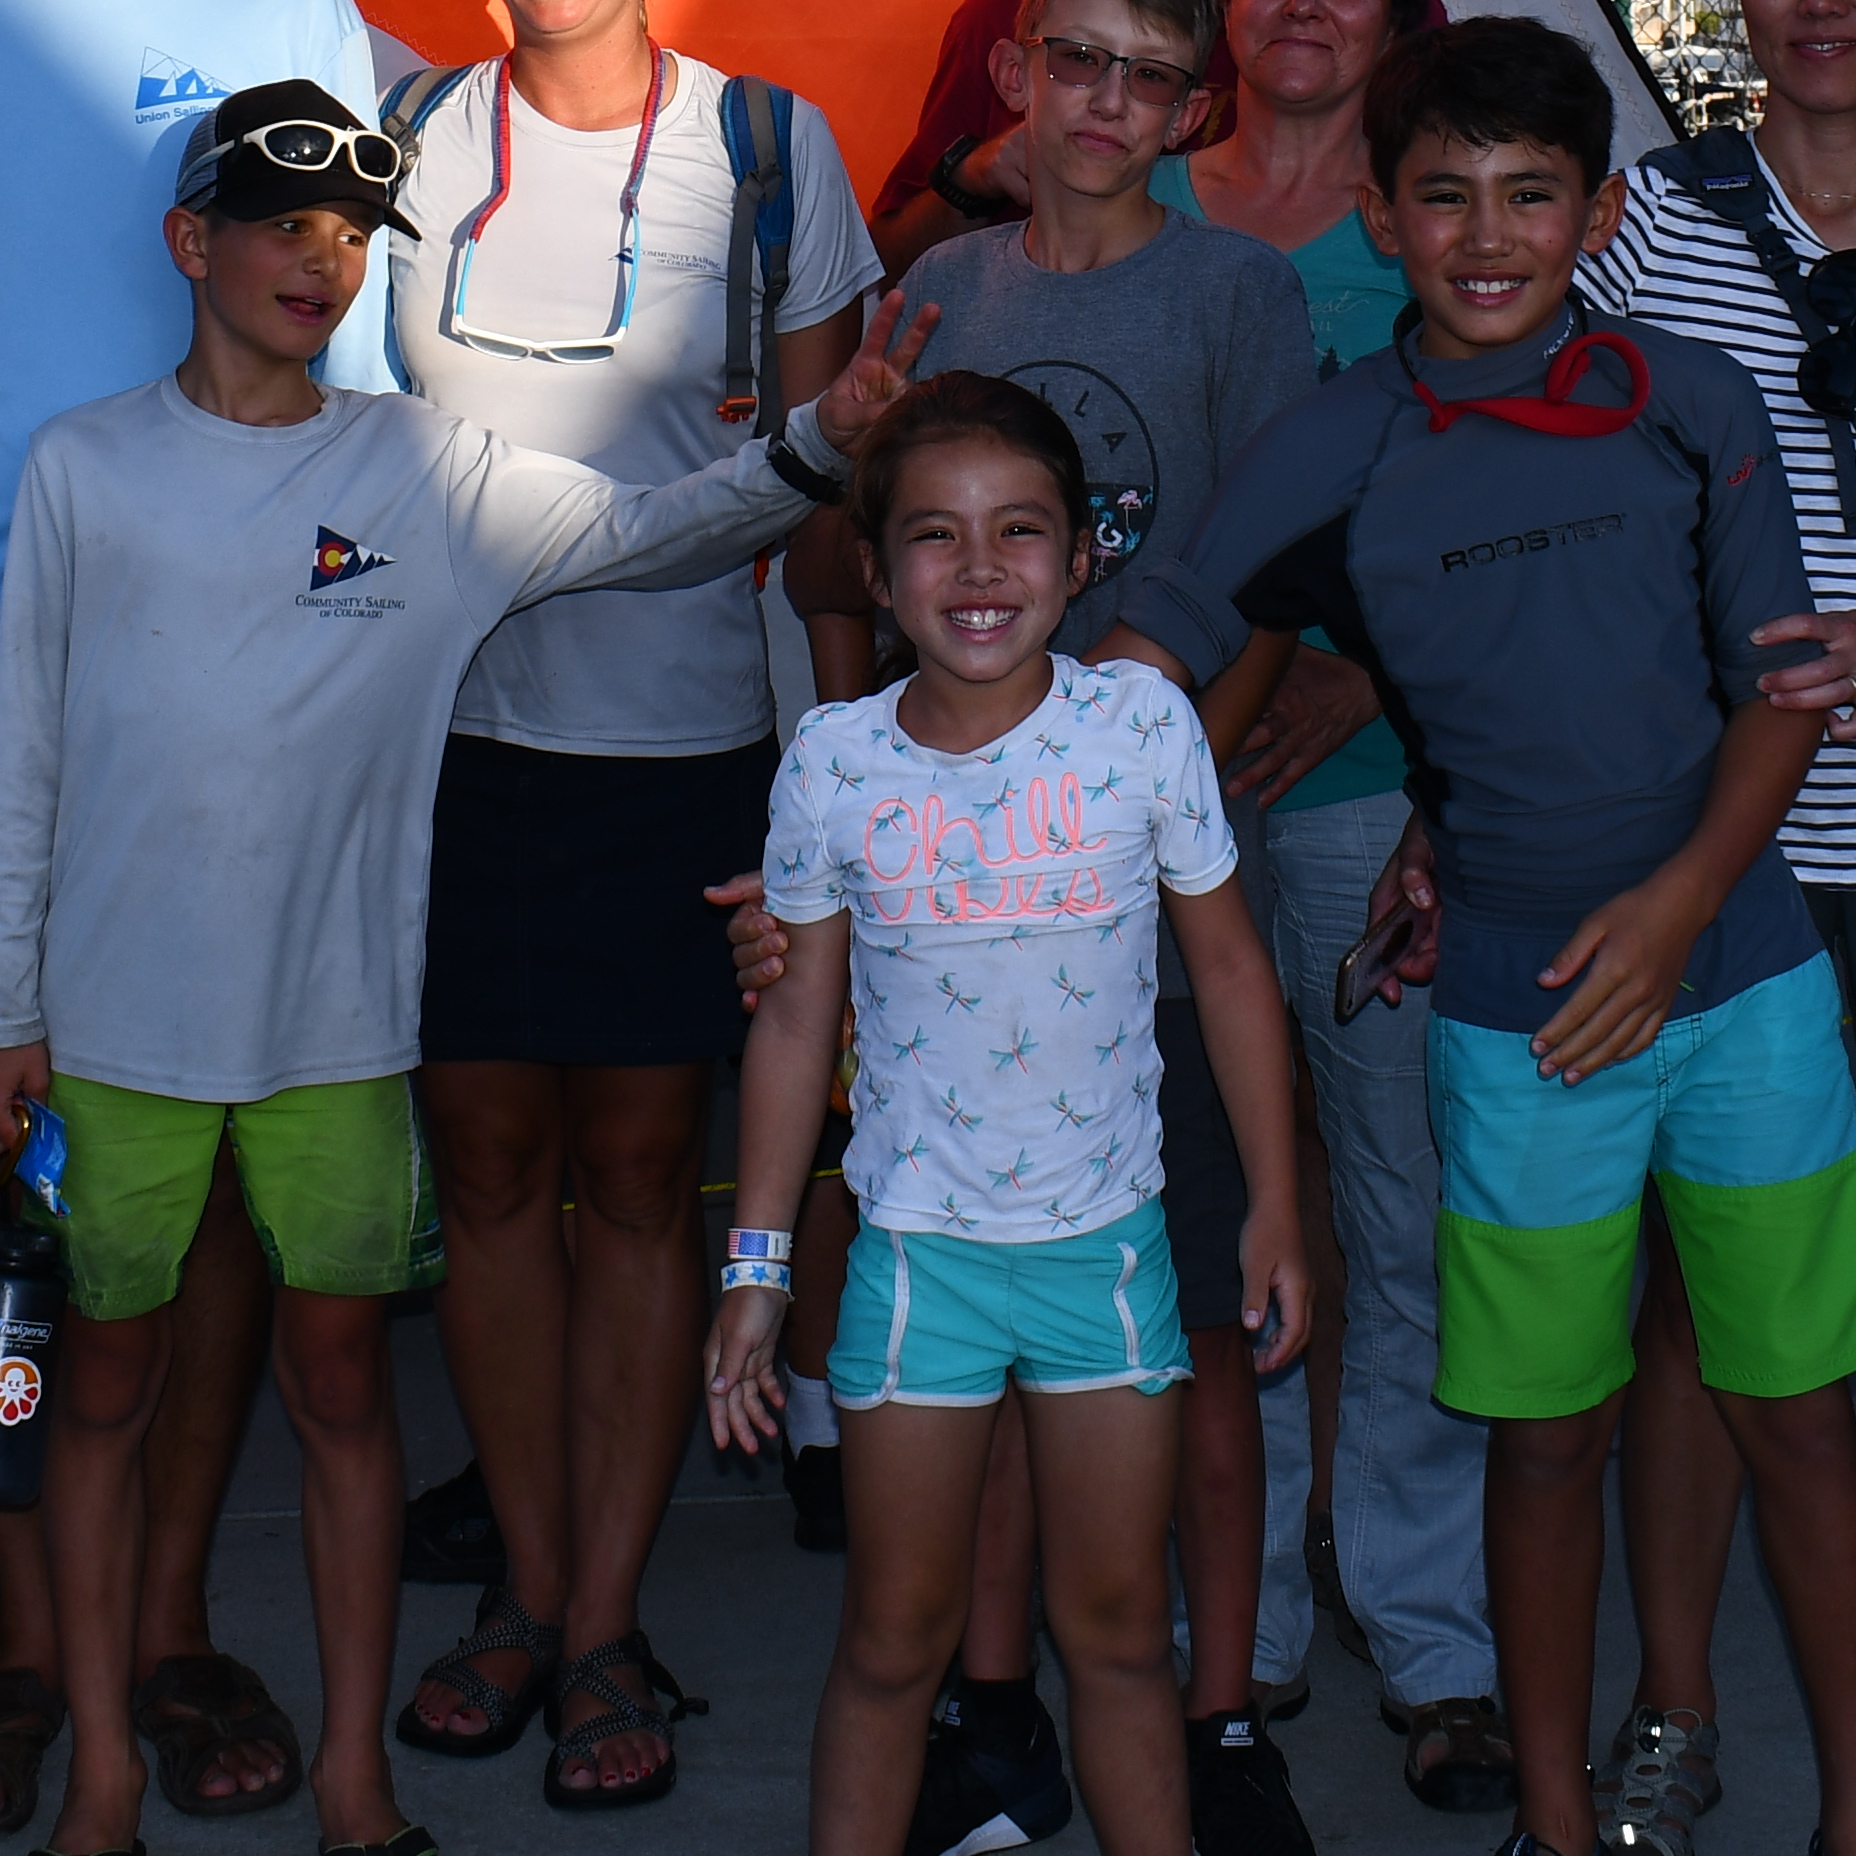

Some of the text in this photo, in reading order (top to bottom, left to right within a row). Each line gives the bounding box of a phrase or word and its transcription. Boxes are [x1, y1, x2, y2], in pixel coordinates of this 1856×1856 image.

[135, 110, 171, 125] Union
[1440, 513, 1625, 573] ROOSTER
[863, 771, 1109, 884] Chill
[1, 1322, 50, 1340] nalgene
[1224, 1720, 1252, 1736] NIKE
